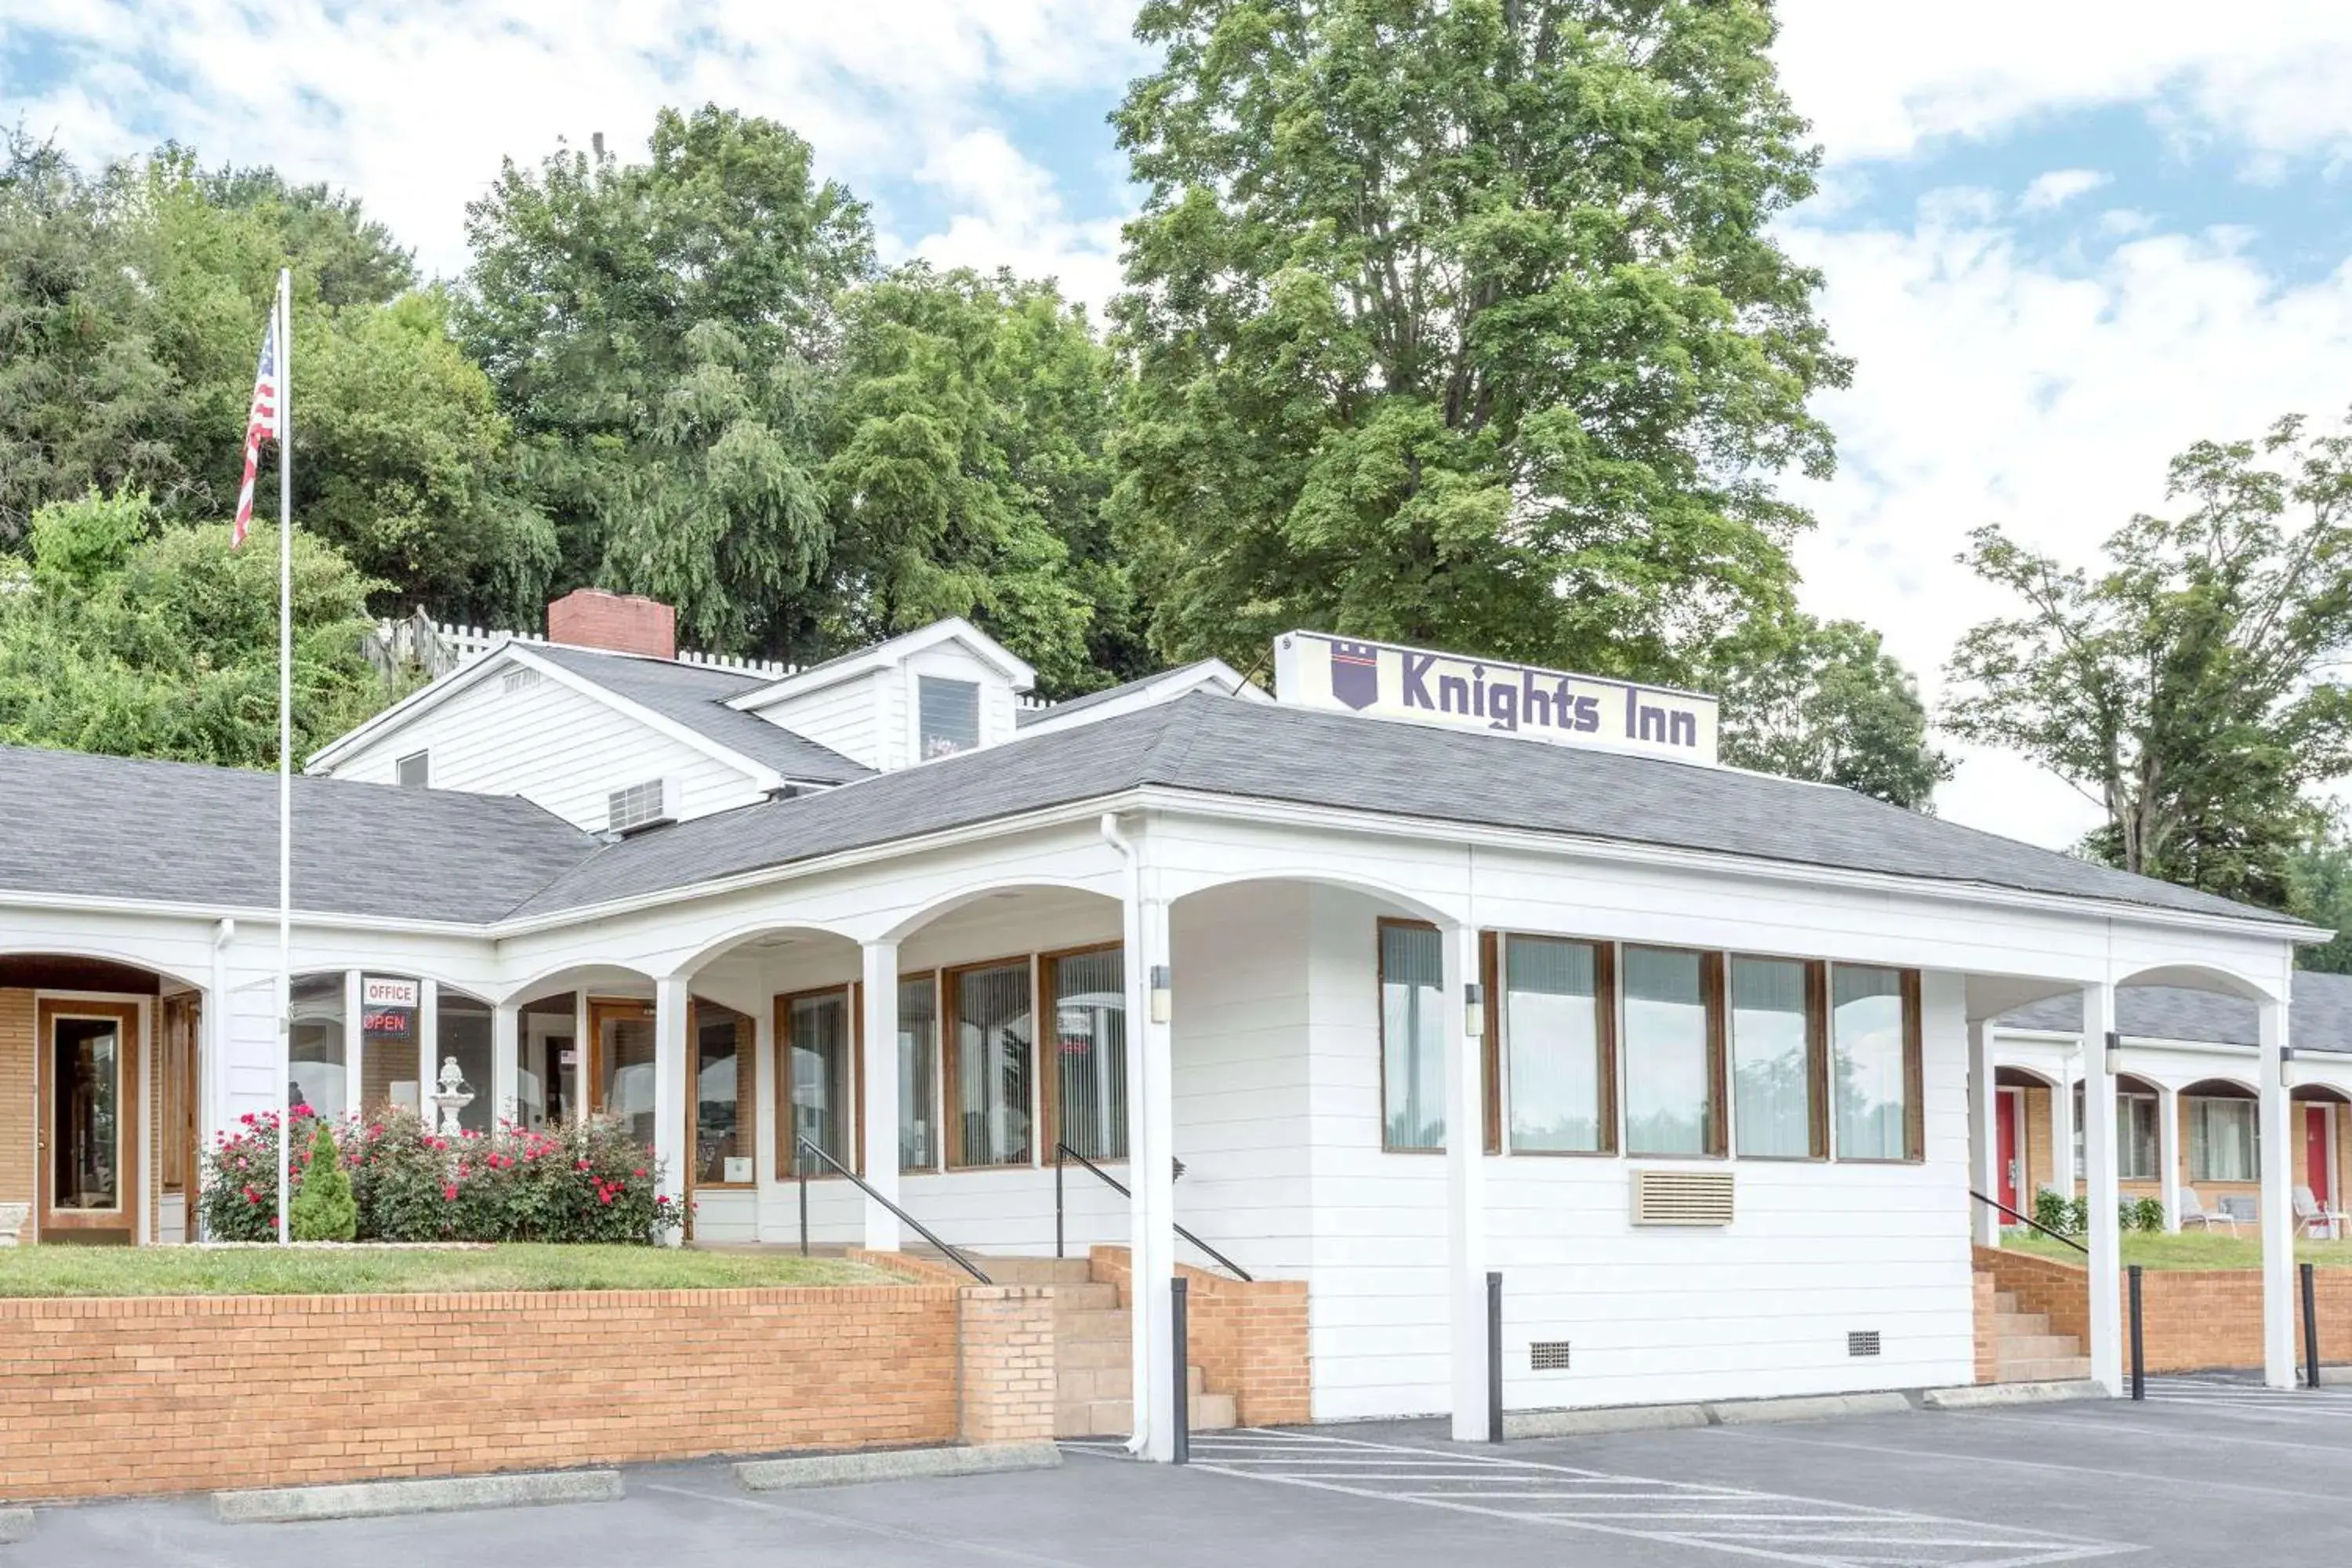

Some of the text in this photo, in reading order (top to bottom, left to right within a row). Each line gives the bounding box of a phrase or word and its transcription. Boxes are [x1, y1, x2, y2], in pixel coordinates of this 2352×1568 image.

[1402, 650, 1696, 747] Knights Inn
[369, 985, 412, 1000] OFFICE
[363, 1014, 405, 1030] OPEN
